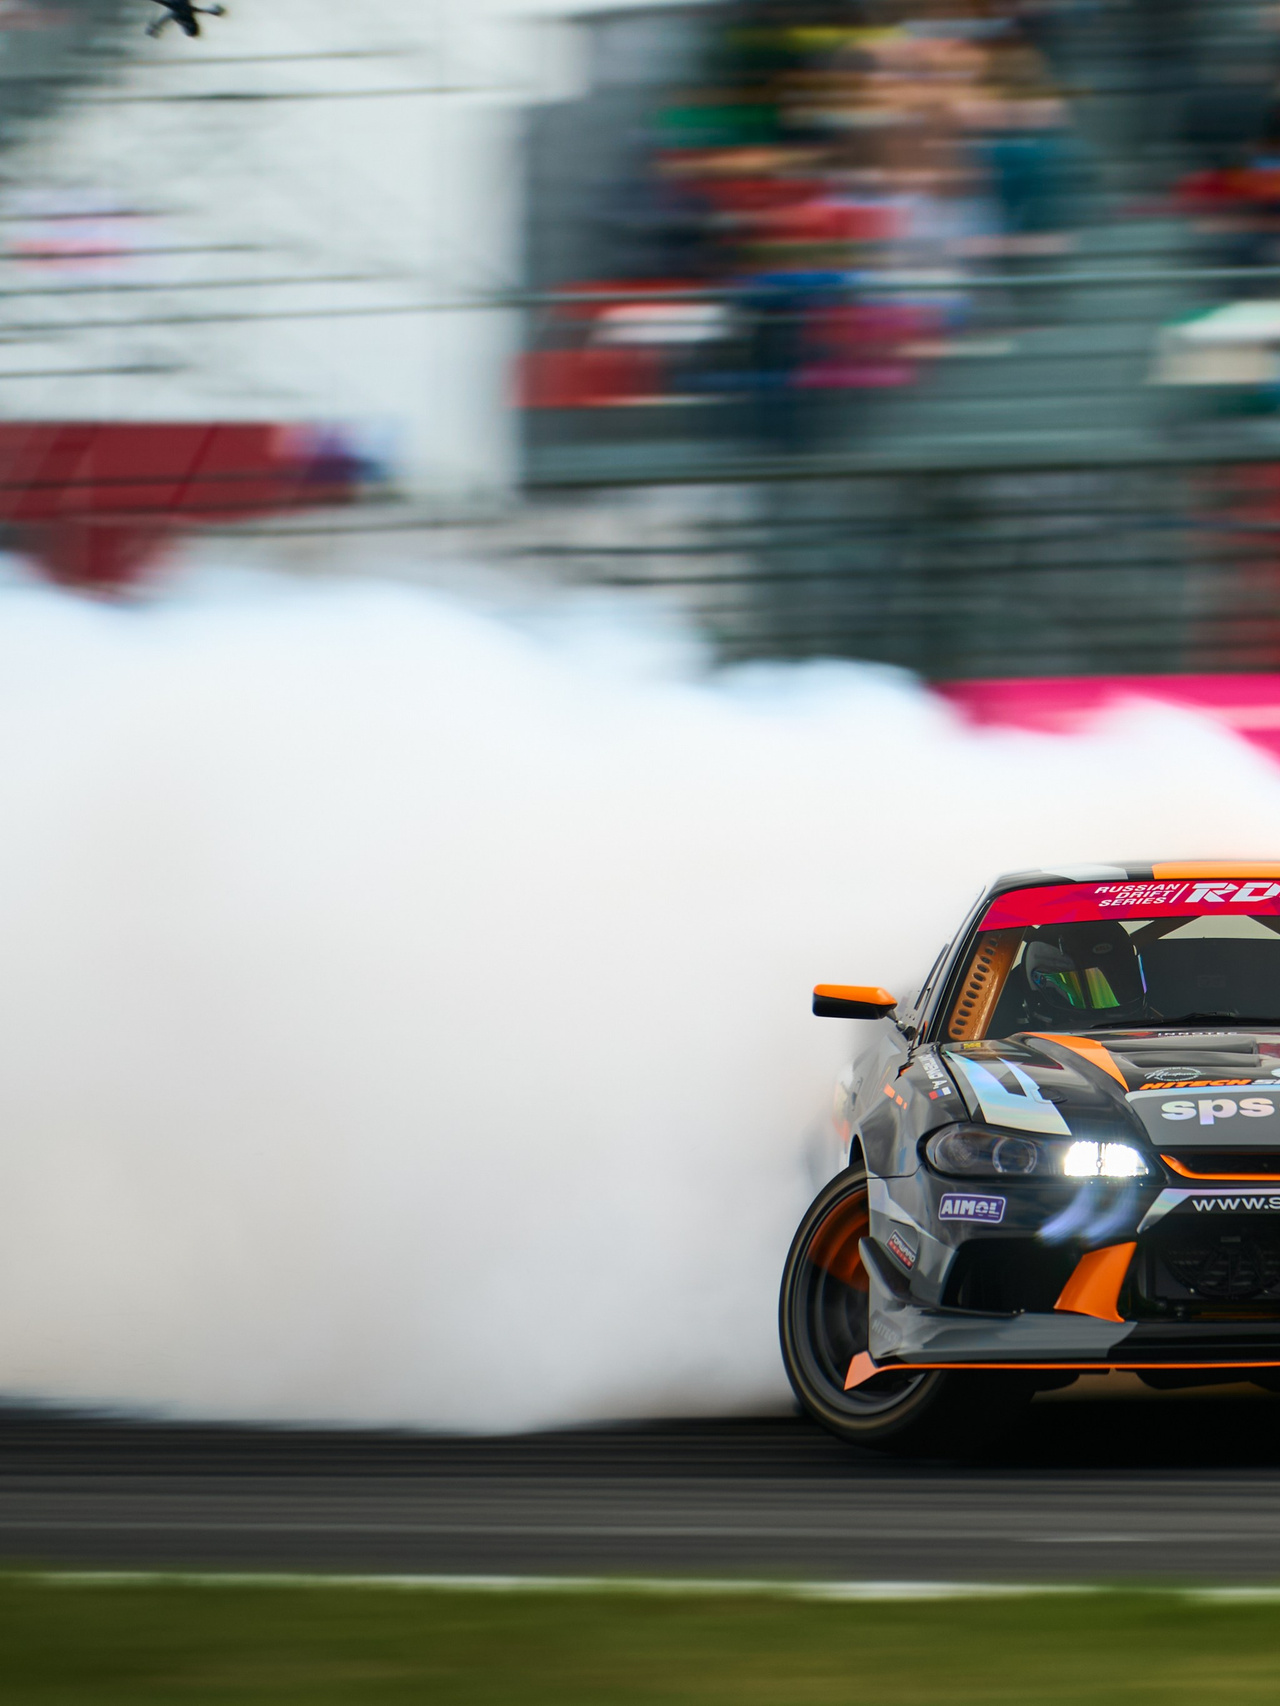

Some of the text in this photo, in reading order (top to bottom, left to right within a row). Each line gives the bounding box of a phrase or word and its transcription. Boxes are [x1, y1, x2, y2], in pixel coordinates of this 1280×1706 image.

[1094, 883, 1180, 894] RUSSIAN
[1115, 890, 1174, 899] DRIFT
[1098, 897, 1167, 907] SERIES
[1139, 1079, 1252, 1090] HITECH
[941, 1200, 1000, 1216] AIMOL
